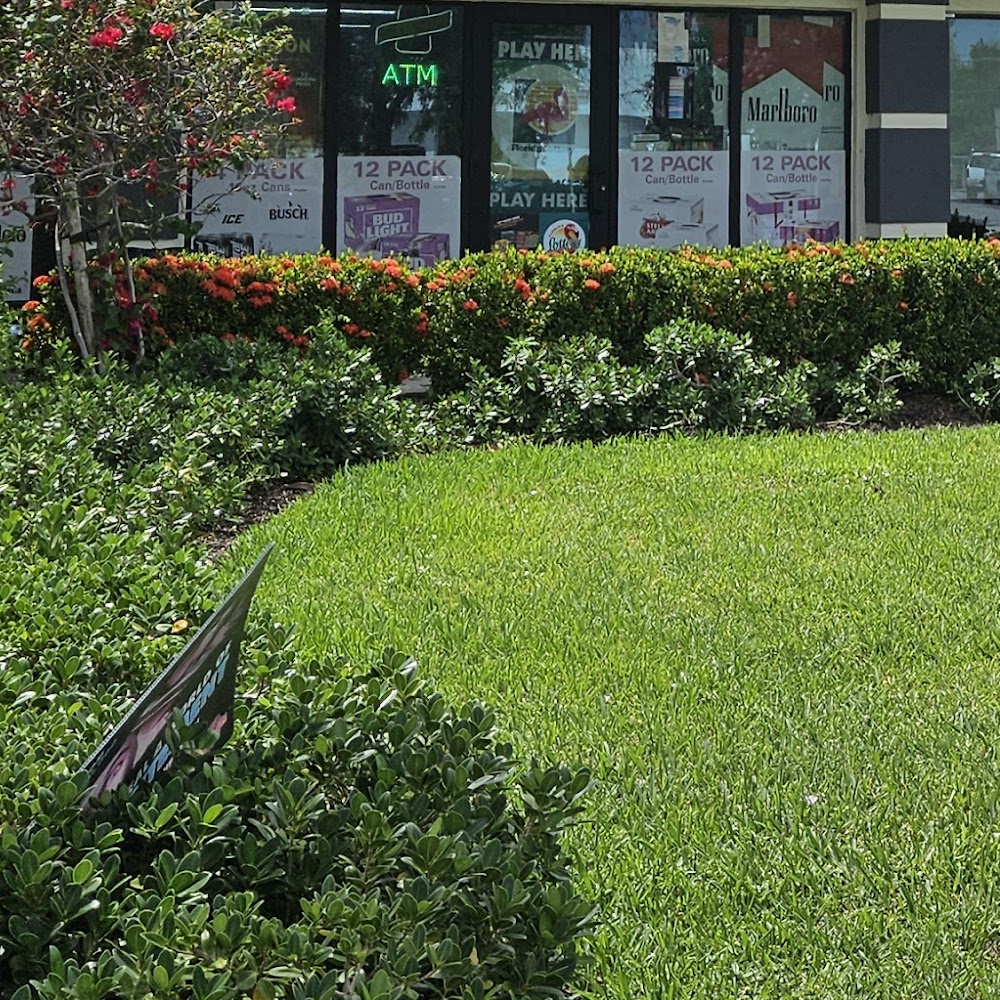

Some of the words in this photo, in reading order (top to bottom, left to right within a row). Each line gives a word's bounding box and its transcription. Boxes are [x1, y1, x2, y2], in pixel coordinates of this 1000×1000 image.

[498, 41, 546, 59] PLAY
[382, 63, 438, 86] ATM
[747, 88, 817, 123] Marlboro
[353, 161, 379, 178] 12
[387, 160, 447, 177] PACK
[631, 156, 654, 172] 12
[661, 155, 714, 172] PACK
[752, 156, 774, 171] 12
[781, 155, 831, 171] PACK
[261, 181, 291, 192] Cans
[370, 180, 430, 191] Can/Bottle
[645, 173, 700, 185] Can/Bottle
[766, 173, 817, 184] Can/Bottle
[490, 192, 535, 207] PLAY
[541, 192, 588, 208] HERE
[222, 214, 244, 224] ICE
[269, 208, 308, 220] BUSCH
[372, 212, 404, 226] BUD
[366, 222, 410, 240] LIGHT
